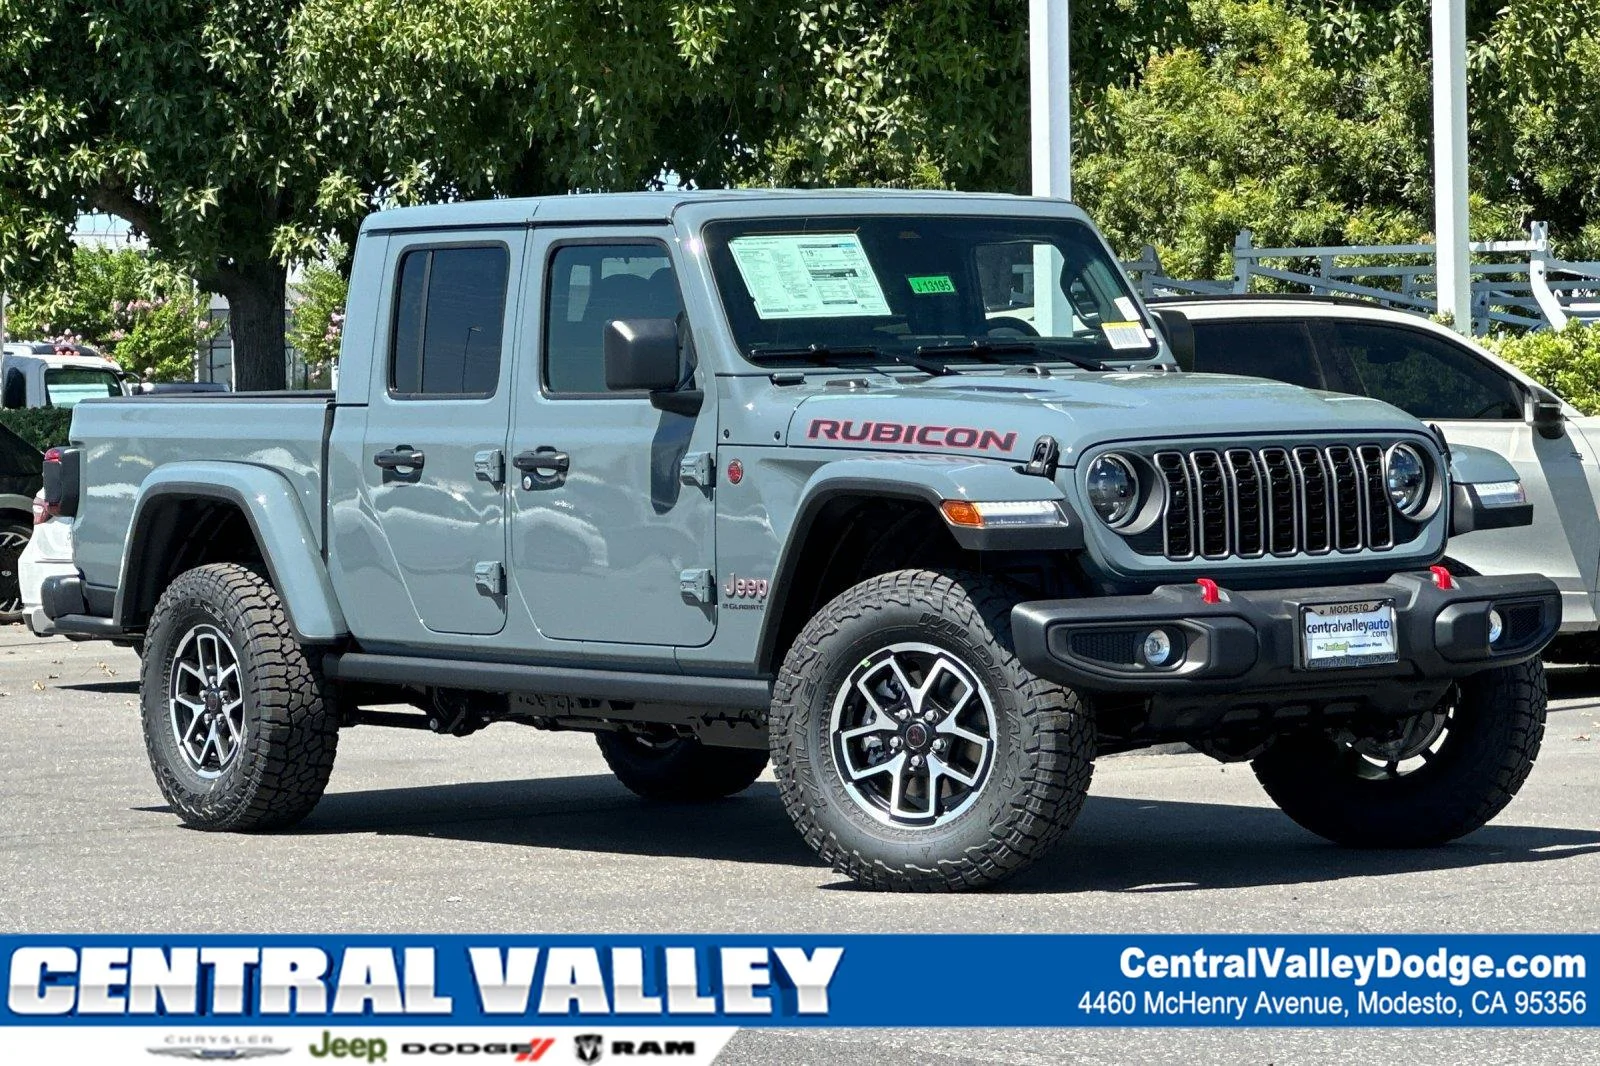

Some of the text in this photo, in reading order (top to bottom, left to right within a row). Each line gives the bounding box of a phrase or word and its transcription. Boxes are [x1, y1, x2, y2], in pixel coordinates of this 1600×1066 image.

[808, 419, 1018, 452] RUBICON
[723, 572, 768, 602] Jeep
[1329, 603, 1369, 615] MODESTO
[1306, 618, 1390, 634] centralvalleyauto
[1370, 630, 1388, 638] .com
